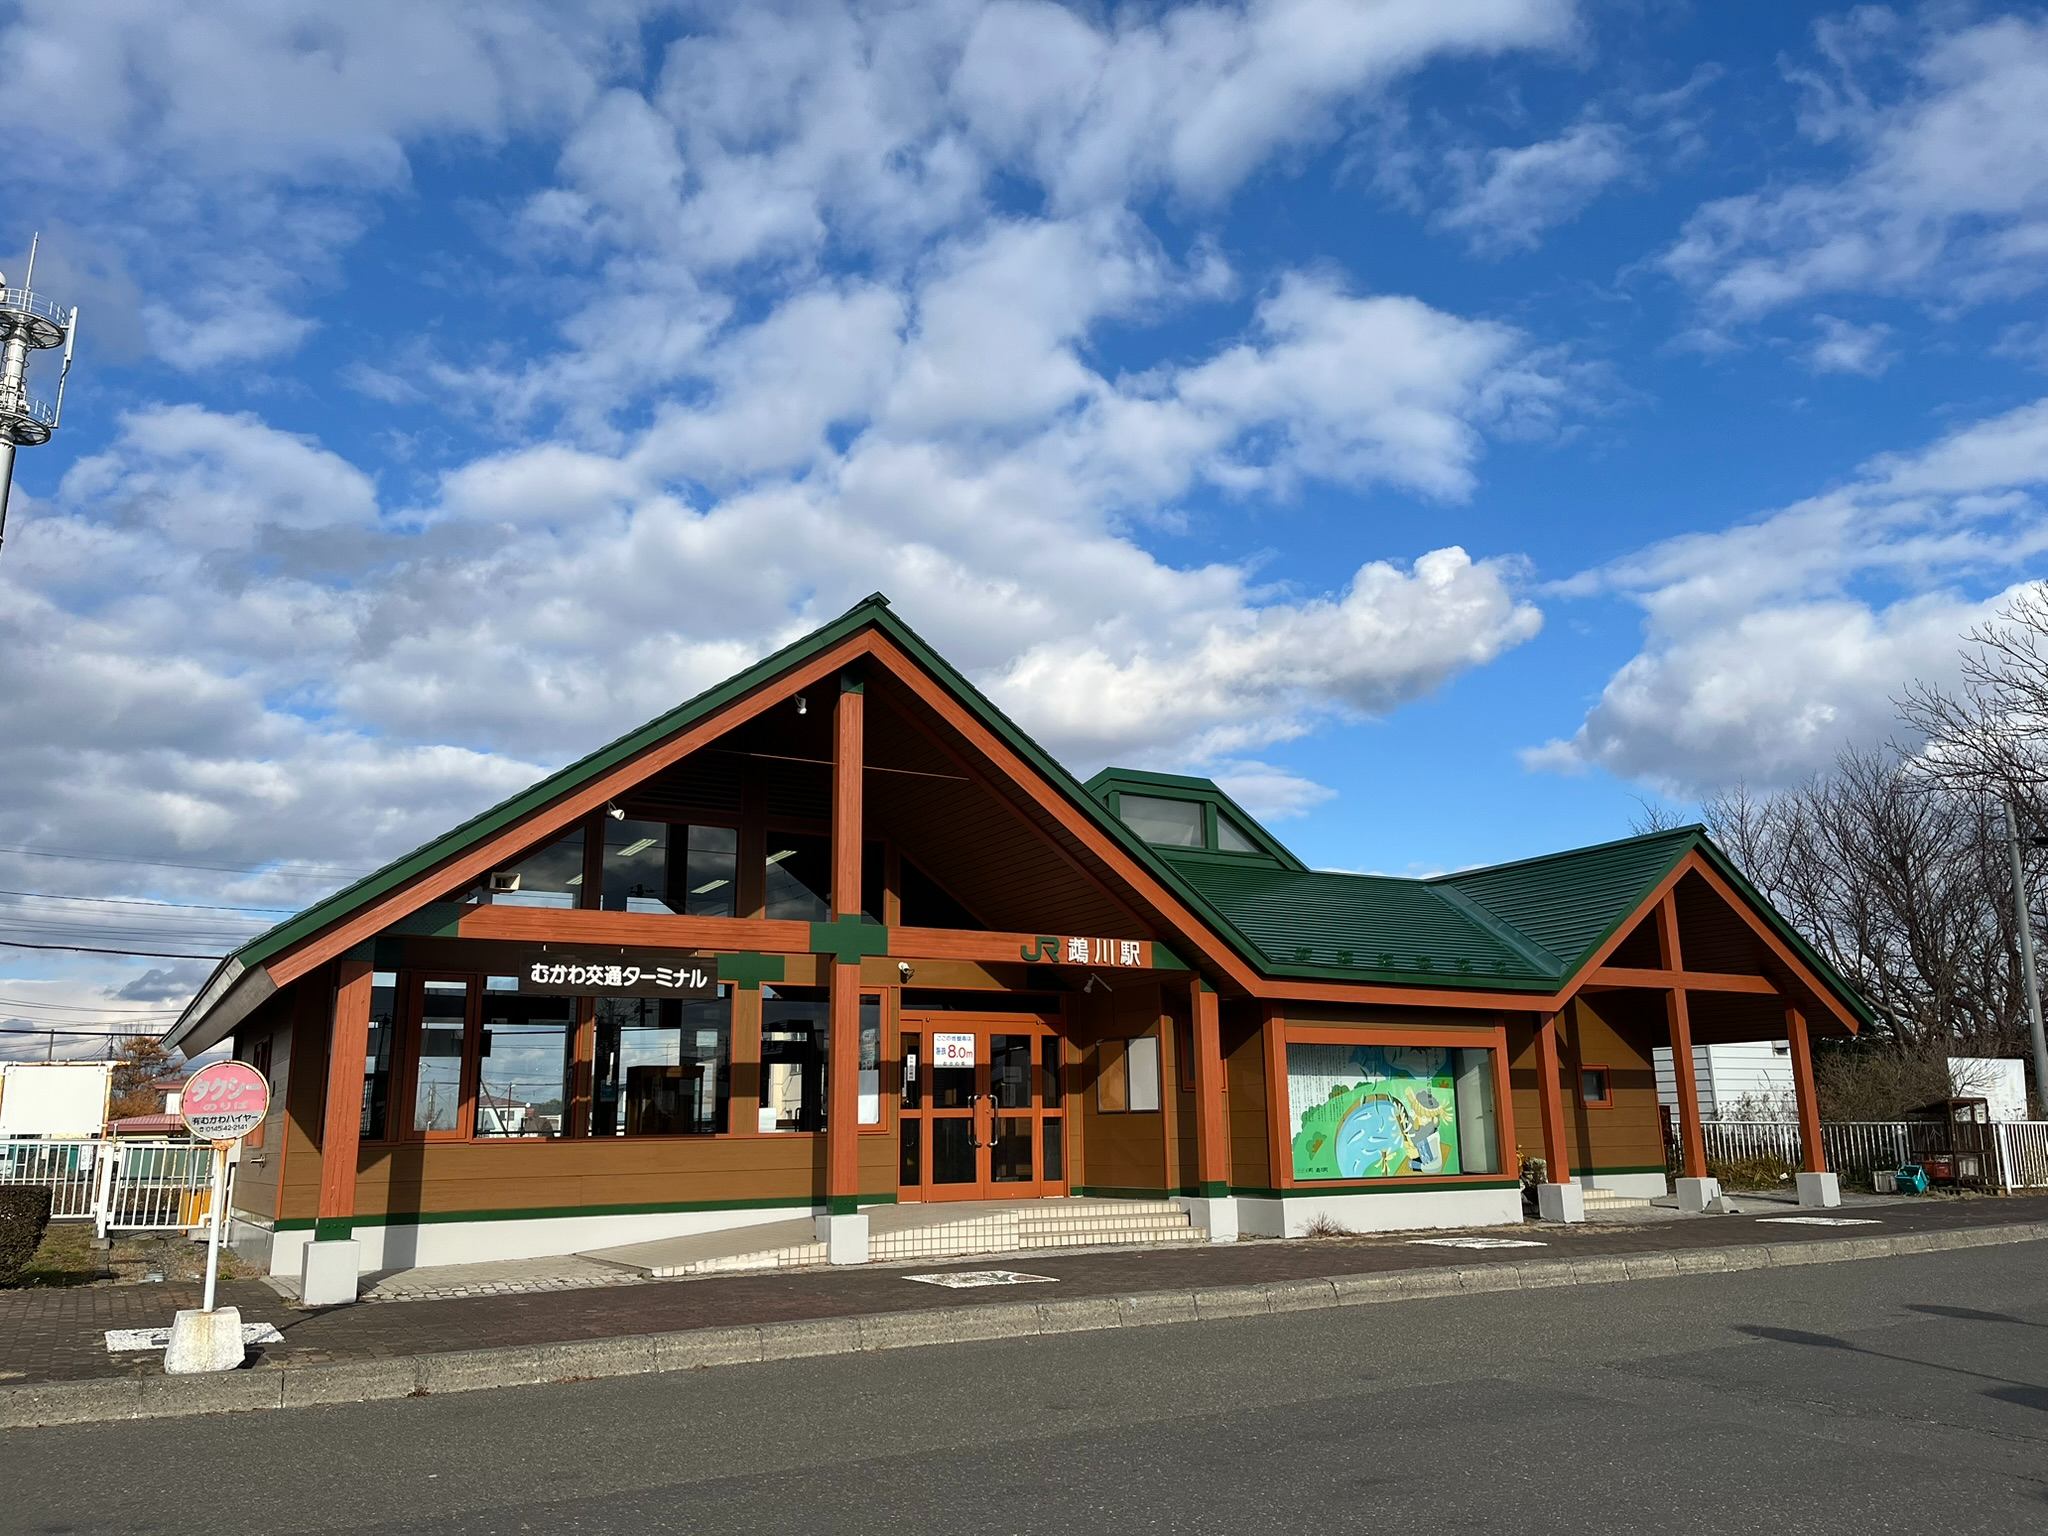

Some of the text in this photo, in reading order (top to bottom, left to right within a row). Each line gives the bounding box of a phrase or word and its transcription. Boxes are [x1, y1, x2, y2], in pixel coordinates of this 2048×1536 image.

[1020, 936, 1060, 962] JR
[1067, 937, 1140, 966] 鵡川駅
[530, 962, 708, 988] むかわ交通ターミナル
[191, 1077, 261, 1102] タクシー
[202, 1101, 249, 1111] のりば
